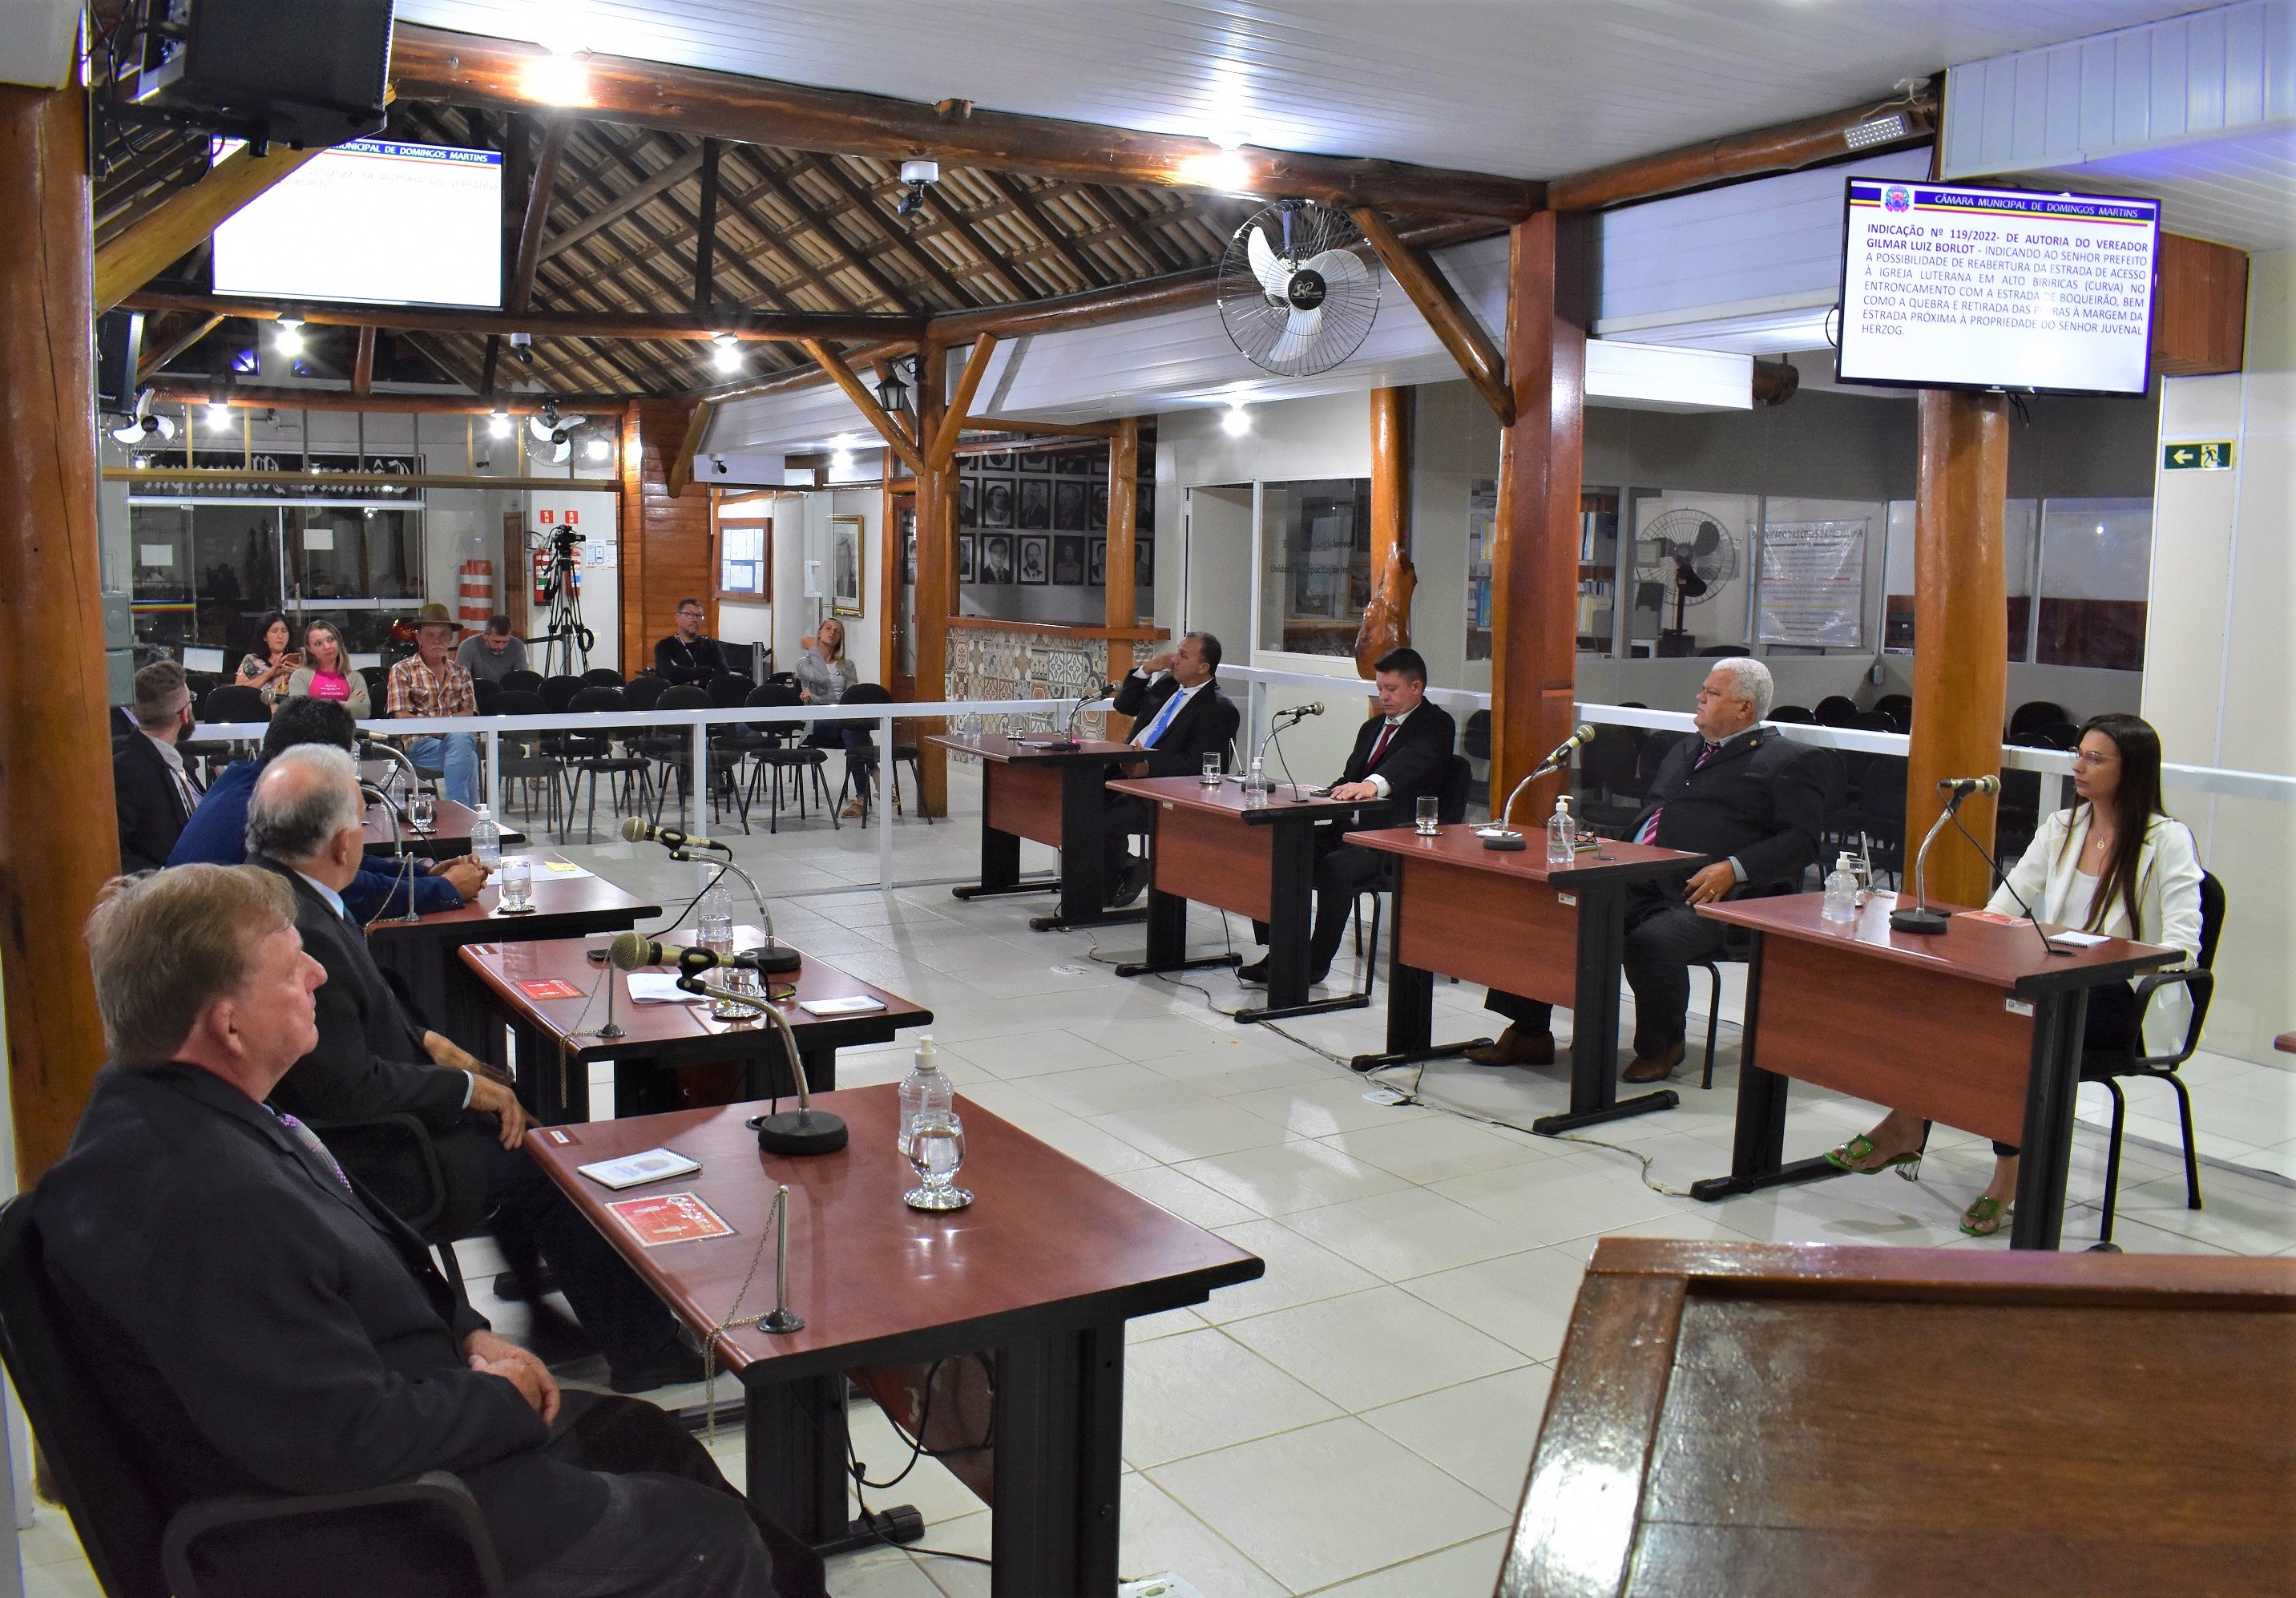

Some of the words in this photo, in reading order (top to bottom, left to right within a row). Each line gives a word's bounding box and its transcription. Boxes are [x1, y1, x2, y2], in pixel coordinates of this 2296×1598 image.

[385, 145, 396, 154] DE
[400, 147, 446, 159] DOMINGOS
[449, 151, 488, 163] MARTINS
[1935, 193, 1974, 206] CÂMARA
[1978, 198, 2027, 210] MUNICIPAL
[2031, 201, 2043, 211] DE
[2047, 203, 2095, 215] DOMINGOS
[2098, 206, 2138, 218] MARTINS
[1867, 223, 1924, 237] INDICAÇÃO
[2006, 232, 2019, 243] DE
[2025, 234, 2069, 246] AUTORIA
[2076, 238, 2090, 248] DO
[2096, 240, 2148, 252] VEREADOR
[1866, 238, 1907, 249] GILMAR
[1911, 240, 1932, 252] LUIZ
[1935, 242, 1975, 253] BORLOT
[1985, 245, 2041, 259] INDICANDO
[2044, 250, 2058, 260] AO
[2061, 251, 2100, 263] SENHOR
[2104, 253, 2147, 266] PREFEITO
[1865, 264, 1872, 276] À
[1879, 268, 1913, 279] IGREJA
[1920, 270, 1971, 282] LUTERANA
[1979, 273, 1994, 284] EM
[2001, 276, 2026, 286] ALTO
[2032, 277, 2078, 289] BIRIRICAS
[2084, 280, 2124, 294] (CURVA)
[2130, 284, 2145, 294] NO
[1866, 252, 1872, 262] A
[1876, 253, 1948, 267] POSSIBILIDADE
[1952, 258, 1964, 268] DE
[1967, 259, 2030, 272] REABERTURA
[2034, 263, 2047, 272] DA
[2050, 264, 2092, 276] ESTRADA
[2096, 267, 2107, 277] DE
[2110, 268, 2146, 280] ACESSO
[1864, 280, 1955, 296] ENTRONCAMENTO
[1959, 286, 1983, 297] COM
[1987, 289, 1994, 298] A
[1997, 289, 2040, 301] ESTRADA
[2060, 293, 2119, 308] BOQUEIRÃO,
[2124, 297, 2145, 308] BEM
[1863, 295, 1896, 306] COMO
[1899, 298, 1906, 307] A
[1909, 298, 1950, 310] QUEBRA
[1953, 301, 1959, 310] E
[1962, 301, 2008, 313] RETIRADA
[2012, 304, 2031, 314] DAS
[2034, 305, 2071, 317] PRAS
[2072, 306, 2080, 317] À
[2084, 309, 2127, 321] MARGEM
[2130, 311, 2143, 321] DA
[1862, 309, 1907, 321] ESTRADA
[1911, 311, 1955, 324] PRÓXIMA
[1960, 313, 1967, 324] À
[1970, 316, 2037, 329] PROPRIEDADE
[2041, 320, 2055, 330] DO
[2058, 321, 2097, 333] SENHOR
[2101, 324, 2141, 335] JUVENAL
[1862, 324, 1905, 336] HERZOG.
